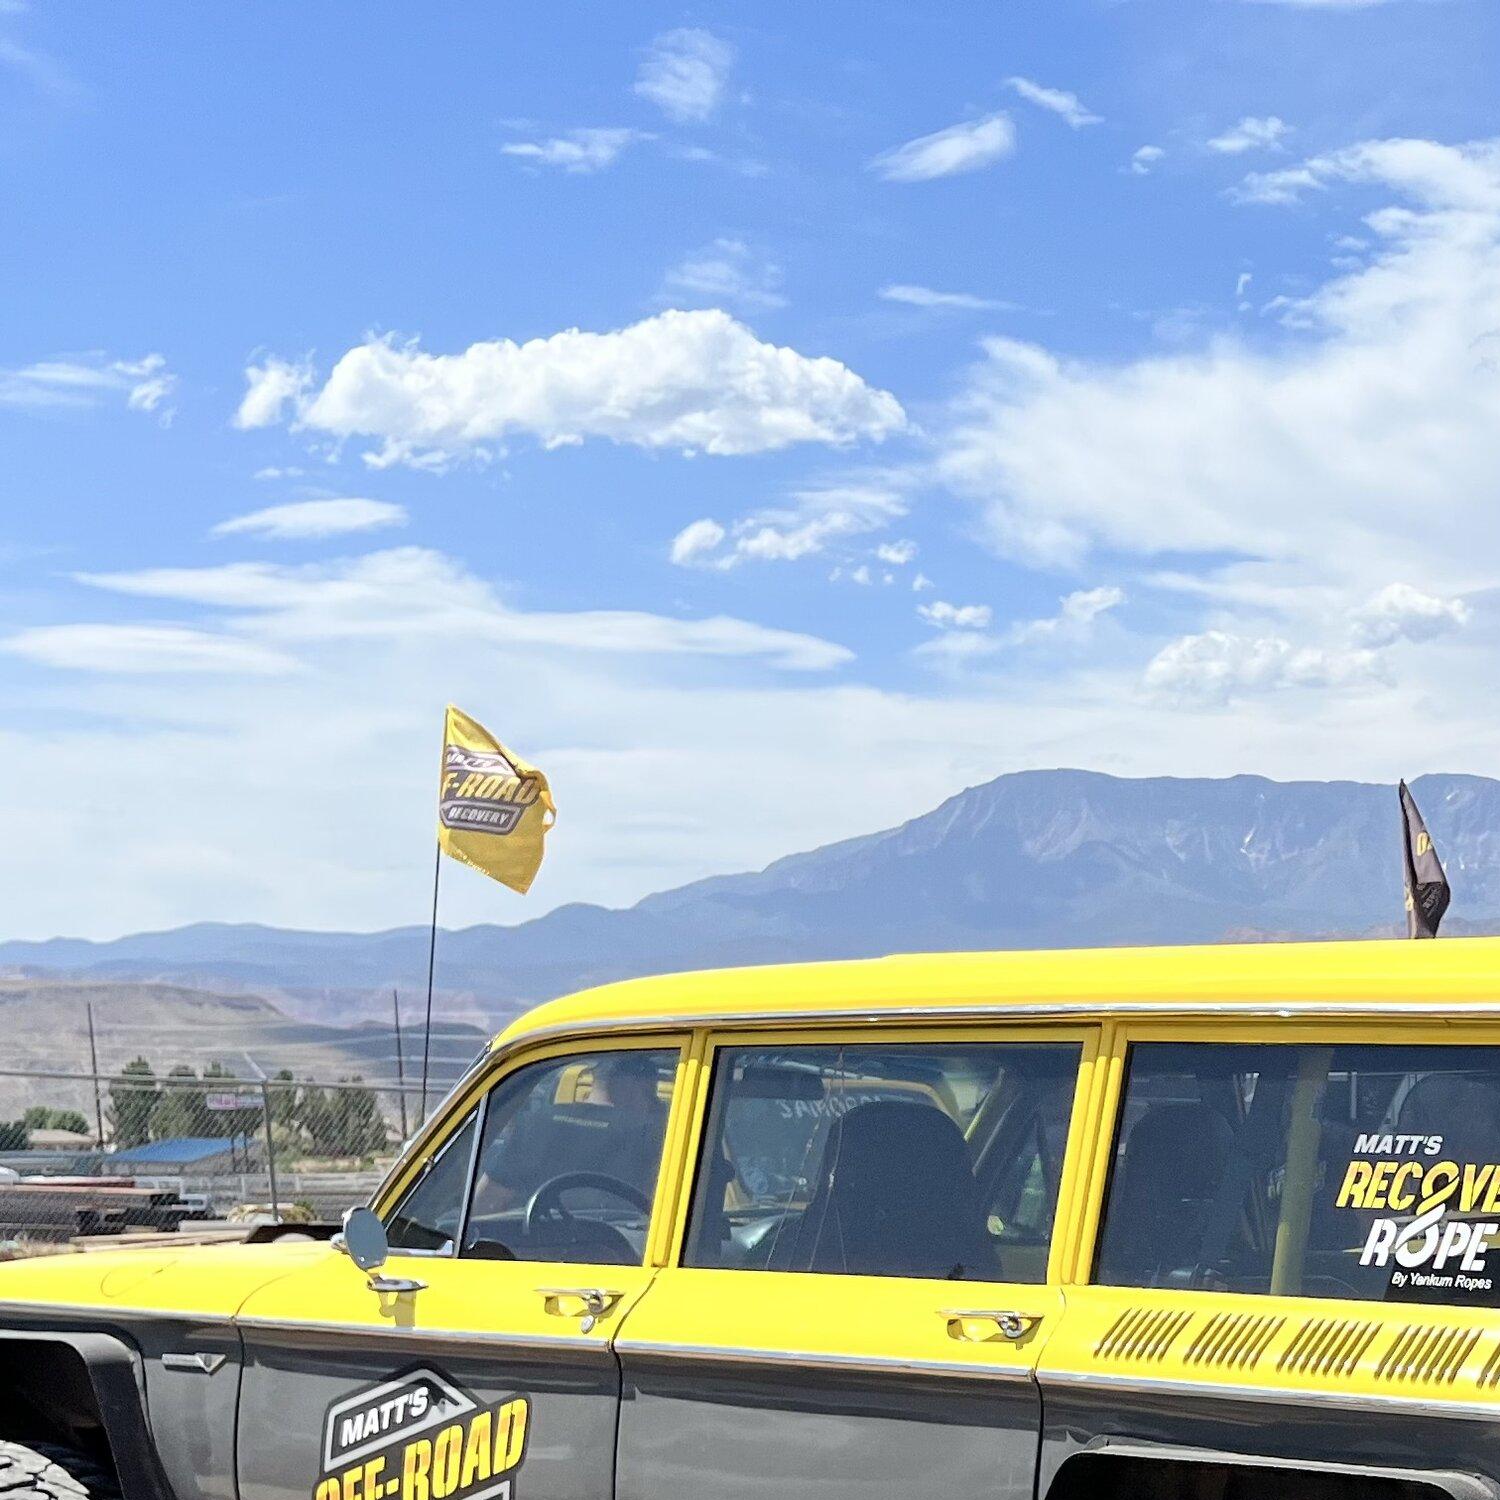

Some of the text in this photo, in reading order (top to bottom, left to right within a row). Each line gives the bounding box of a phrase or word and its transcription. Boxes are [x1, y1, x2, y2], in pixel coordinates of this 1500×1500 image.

[447, 806, 510, 824] RECOVERY
[1353, 1134, 1443, 1155] MATT'S
[1359, 1203, 1499, 1271] ROPE
[1391, 1271, 1492, 1291] By Yankum Ropes
[340, 1386, 430, 1447] MATT'S
